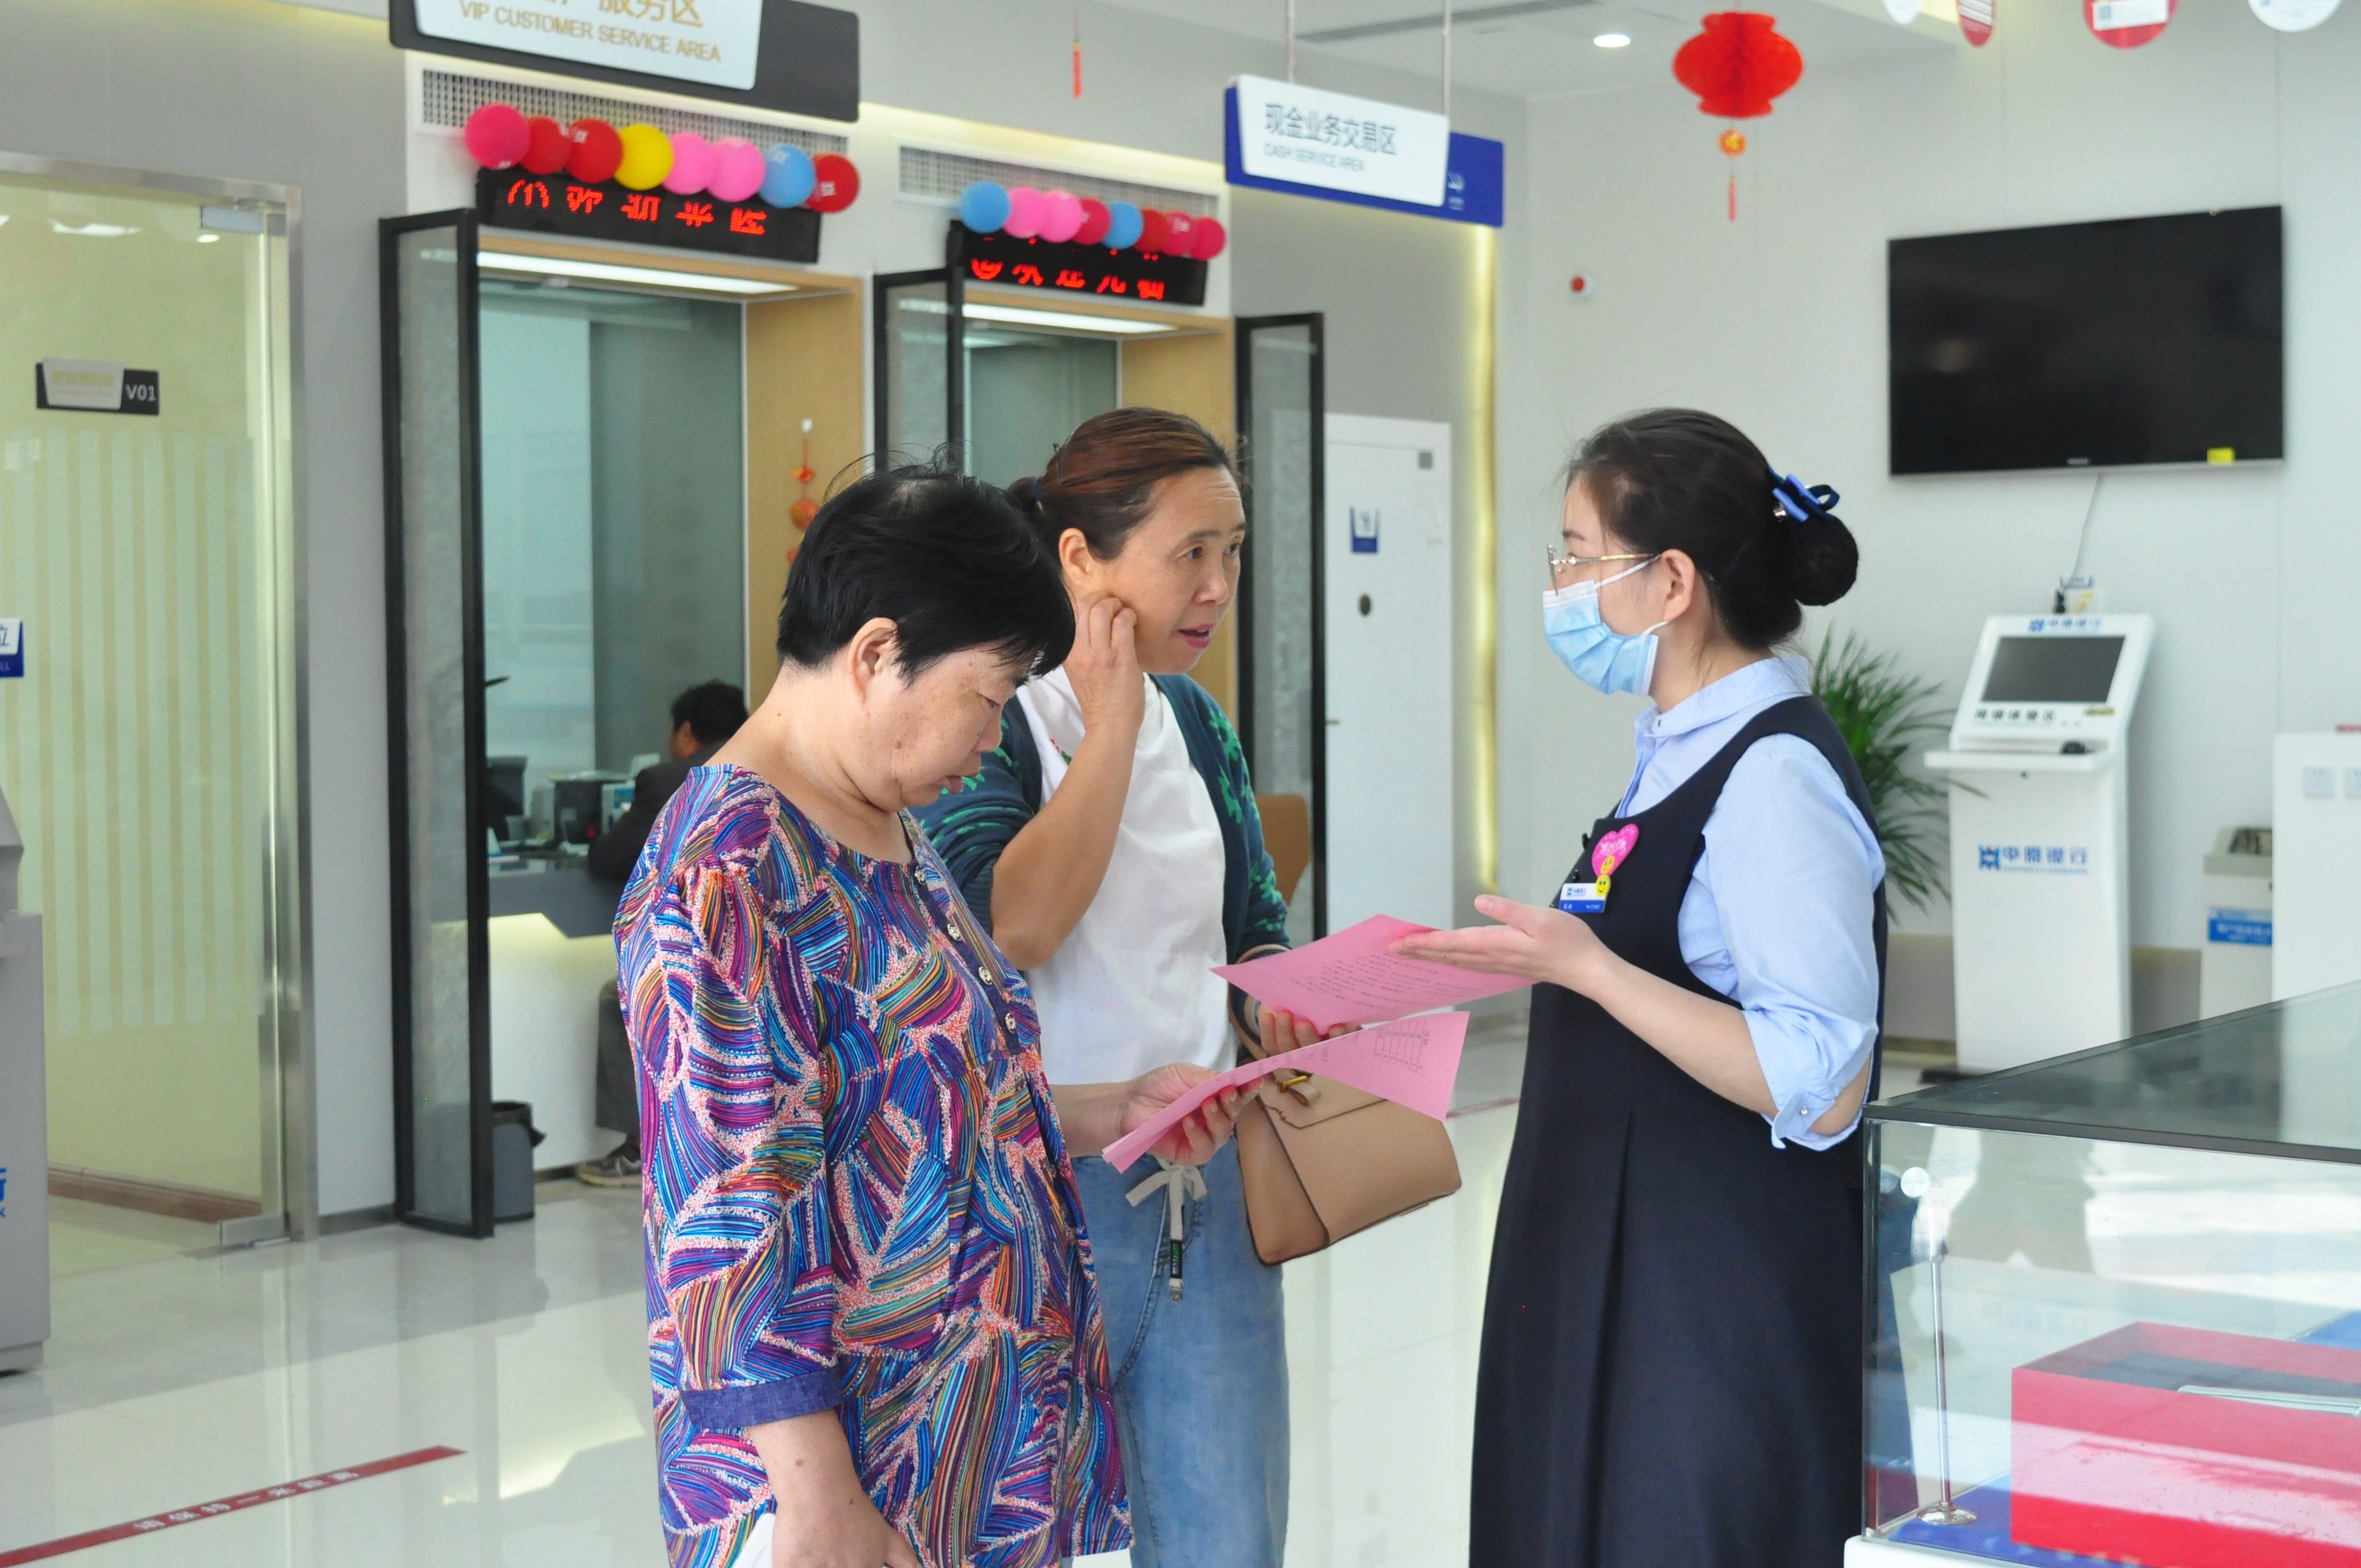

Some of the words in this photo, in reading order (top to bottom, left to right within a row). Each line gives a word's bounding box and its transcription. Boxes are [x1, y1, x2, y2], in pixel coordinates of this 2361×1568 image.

[459, 0, 489, 19] VIP
[495, 6, 594, 40] CUSTOMER
[599, 25, 671, 53] SERVICE
[676, 38, 721, 62] AREA
[1265, 104, 1396, 155] 现金业务交易区
[1264, 141, 1292, 159] CASH
[1294, 149, 1338, 168] SERVICE
[1340, 157, 1364, 172] AREA
[125, 384, 157, 402] V01
